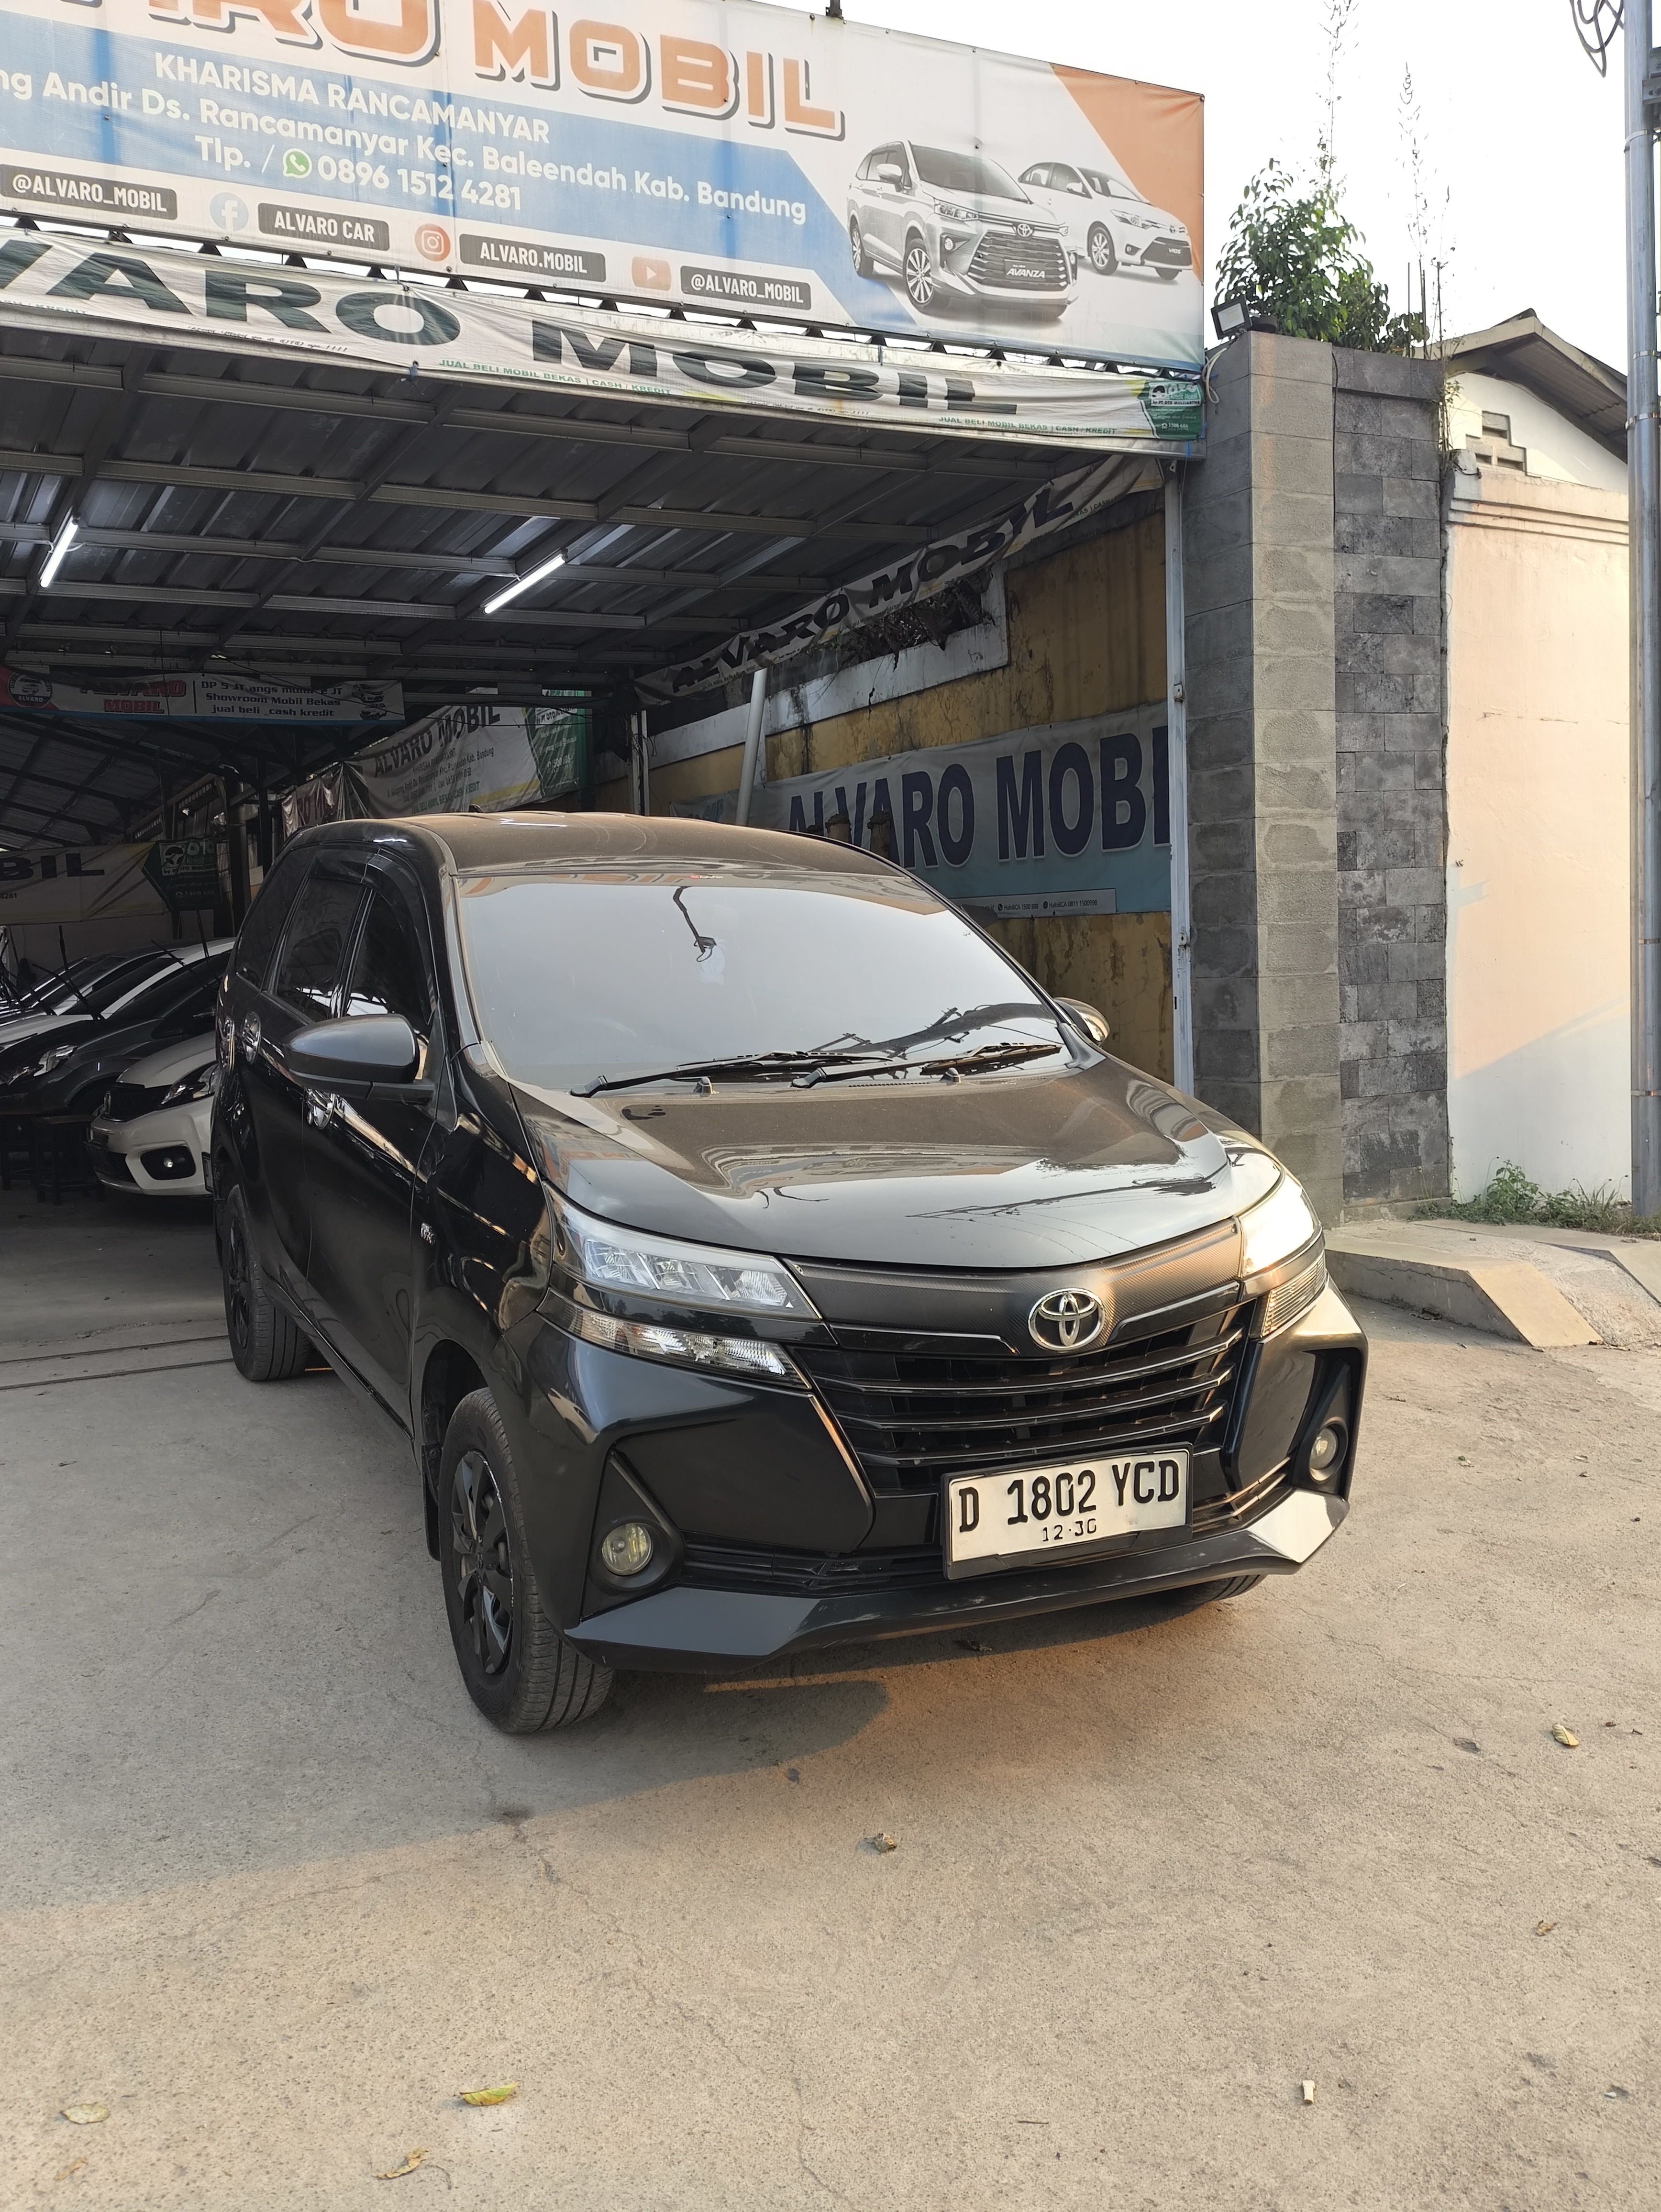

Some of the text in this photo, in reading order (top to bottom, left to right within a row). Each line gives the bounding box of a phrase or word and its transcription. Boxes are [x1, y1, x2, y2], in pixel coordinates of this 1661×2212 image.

[474, 0, 845, 141] MOBIL
[155, 52, 550, 144] KHARISMA RANCAMANYAR
[43, 72, 132, 110] Andir
[142, 88, 190, 121] Ds.
[200, 98, 408, 157] Rancamanyar
[418, 136, 474, 167] Kec.
[483, 146, 626, 192] Baleendah
[634, 171, 689, 202] Kab.
[698, 182, 807, 225] Bandung
[196, 135, 251, 171] Tlp.
[318, 155, 390, 190] 0896
[398, 167, 453, 199] 1512
[462, 180, 520, 210] 4281
[12, 173, 167, 212] @ALVARO_MOBIL
[275, 210, 375, 243] ALVARO CAR
[480, 242, 587, 274] ALVARO.MOBIL
[1007, 268, 1045, 278] AVANZA
[691, 273, 803, 304] @ALVARO_MOBIL
[439, 359, 469, 369] JUAL
[473, 365, 499, 374] BELI
[503, 367, 541, 379] MOBIL
[543, 373, 582, 384] BEKAS
[592, 379, 622, 389] CASH
[631, 385, 671, 395] KREDIT
[532, 320, 1017, 415] MOBIL
[988, 420, 1016, 429] MOBIL
[201, 681, 217, 689] DP
[248, 685, 278, 694] angs
[206, 693, 340, 706] Showroom Mobil Bekas
[103, 699, 165, 713] MOBIL
[211, 705, 234, 714] jual
[239, 706, 260, 714] beli
[300, 708, 334, 717] kredit
[546, 711, 555, 720] OTO
[375, 729, 433, 778] ALVARO
[436, 706, 500, 747] MOBIL
[477, 748, 494, 761] Bandung
[997, 725, 1171, 863] MOBI
[959, 1459, 1179, 1533] D 1802 YCD
